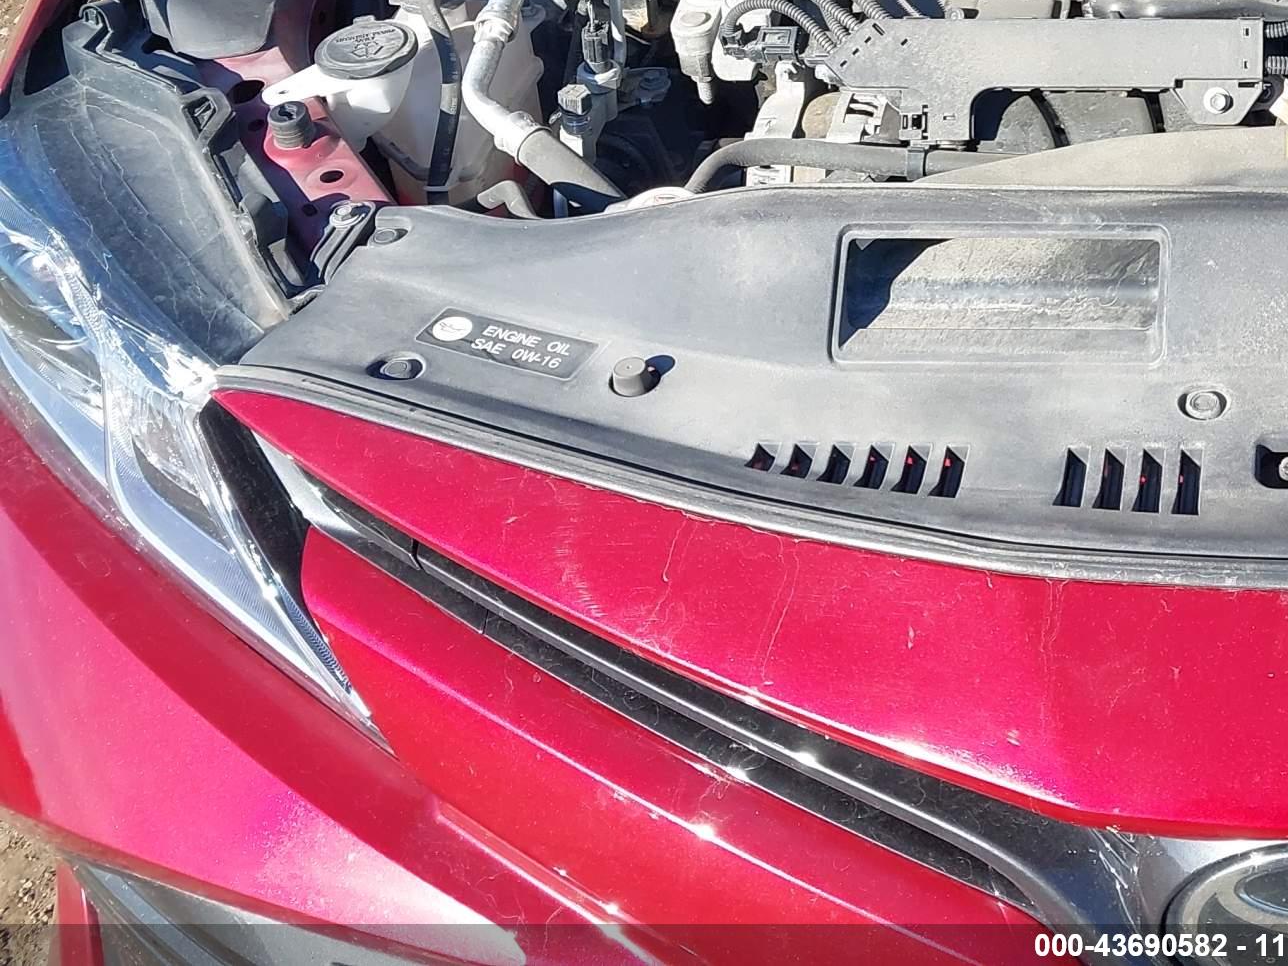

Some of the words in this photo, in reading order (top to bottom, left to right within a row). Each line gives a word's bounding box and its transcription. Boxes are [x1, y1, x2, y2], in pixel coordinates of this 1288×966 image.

[471, 338, 506, 355] SAE
[511, 348, 562, 369] 0W-16
[482, 325, 542, 348] ENGINE
[547, 340, 571, 356] OIL
